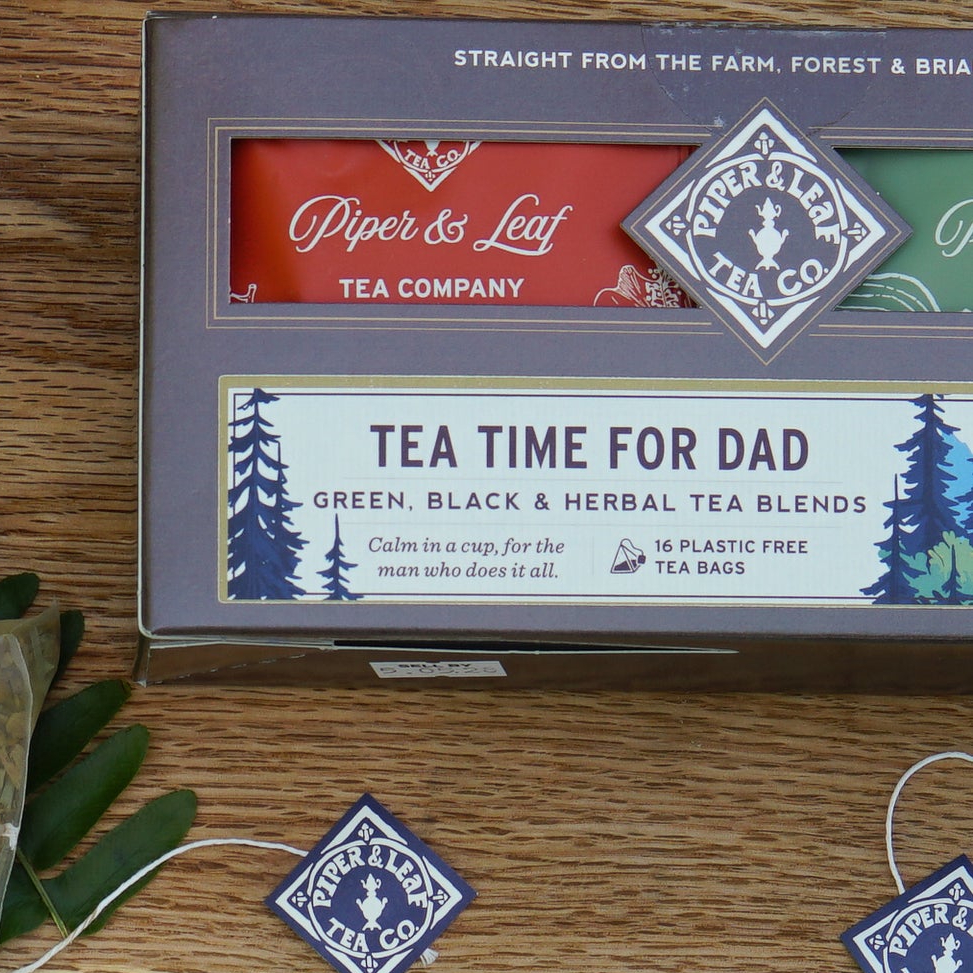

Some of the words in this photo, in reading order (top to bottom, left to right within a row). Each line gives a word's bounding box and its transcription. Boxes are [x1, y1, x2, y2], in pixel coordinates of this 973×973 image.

[454, 50, 572, 68] STRAIGHT
[582, 52, 646, 70] FROM
[655, 54, 702, 71] THE
[712, 55, 781, 75] FARM,
[791, 56, 881, 74] FOREST
[891, 58, 906, 75] &
[404, 149, 431, 169] TEA
[692, 160, 763, 238] PIPER
[764, 161, 787, 193] &
[288, 195, 419, 253] Piper
[423, 208, 468, 245] &
[472, 193, 574, 256] Leaf
[709, 251, 764, 298] TEA
[339, 278, 390, 298] TEA
[397, 278, 525, 298] COMPANY
[370, 424, 458, 468] TEA
[477, 425, 588, 469] TIME
[609, 426, 697, 470] FOR
[718, 428, 809, 471] DAD
[313, 491, 413, 512] GREEN,
[427, 492, 520, 510] BLACK
[534, 493, 551, 511] &
[565, 493, 676, 512] HERBAL
[690, 494, 743, 513] TEA
[757, 495, 867, 514] BLENDS
[368, 536, 421, 553] Calm
[423, 537, 443, 553] in
[445, 541, 458, 553] a
[461, 541, 499, 557] cup,
[501, 537, 532, 557] for
[535, 538, 565, 555] the
[654, 539, 674, 554] 16
[680, 539, 756, 554] PLASTIC
[762, 540, 809, 554] FREE
[377, 565, 420, 578] man
[424, 562, 462, 578] who
[465, 562, 507, 578] does
[510, 562, 526, 578] it
[529, 562, 559, 579] all.
[655, 561, 691, 575] TEA
[697, 561, 746, 575] BAGS
[312, 846, 366, 908] PIPER
[367, 845, 384, 869] &
[326, 917, 370, 953] TEA
[889, 903, 950, 957] PIPER
[951, 906, 968, 931] &
